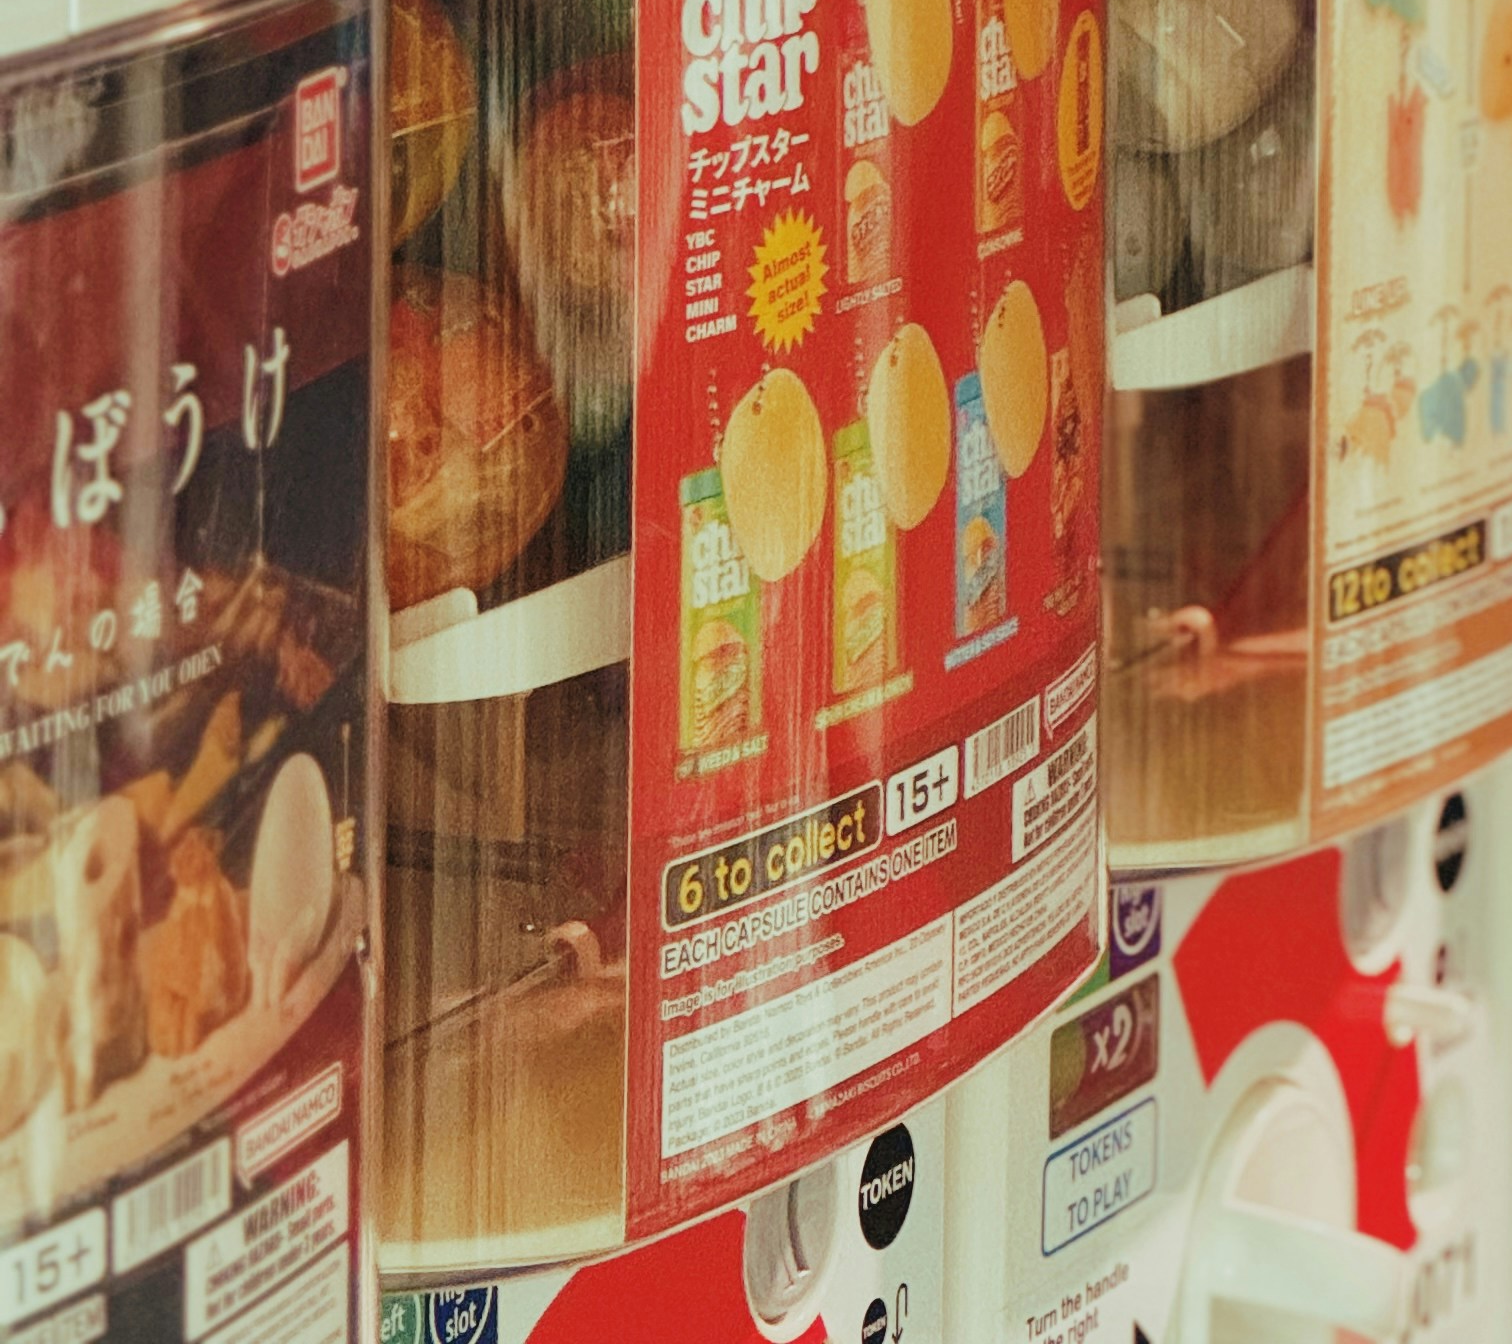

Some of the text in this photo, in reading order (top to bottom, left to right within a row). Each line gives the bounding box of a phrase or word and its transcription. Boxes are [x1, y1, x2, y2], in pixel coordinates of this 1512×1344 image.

[681, 31, 819, 137] star
[688, 128, 811, 183] チップスター
[689, 162, 811, 220] ミニチャーム
[685, 228, 715, 250] YBC
[685, 250, 721, 274] CHIP
[762, 241, 812, 283] Almost
[685, 272, 723, 298] STAR
[685, 296, 719, 320] MINI
[767, 264, 811, 305] actual
[776, 290, 810, 324] size!
[685, 314, 737, 344] CHARM
[1332, 525, 1480, 616] 12 to collect
[97, 682, 134, 721] FOR
[138, 665, 174, 707] YOU
[178, 642, 224, 686] ODEN
[896, 763, 949, 822] 15+
[679, 863, 703, 913] 6
[715, 855, 751, 901] to
[767, 800, 866, 882] collect
[664, 821, 956, 974] EACH CAPSULE CONTAINS ONE ITEM
[663, 997, 701, 1018] Image
[704, 989, 714, 1003] is
[716, 981, 734, 999] for
[1091, 1004, 1133, 1074] x2
[1070, 1119, 1132, 1182] TOKENS
[860, 1156, 913, 1211] TOKEN
[1067, 1169, 1132, 1232] TO PLAY
[12, 1233, 91, 1305] 15+
[382, 1303, 406, 1343] eft
[446, 1301, 477, 1343] slot
[1027, 1263, 1130, 1342] Turn the handle
